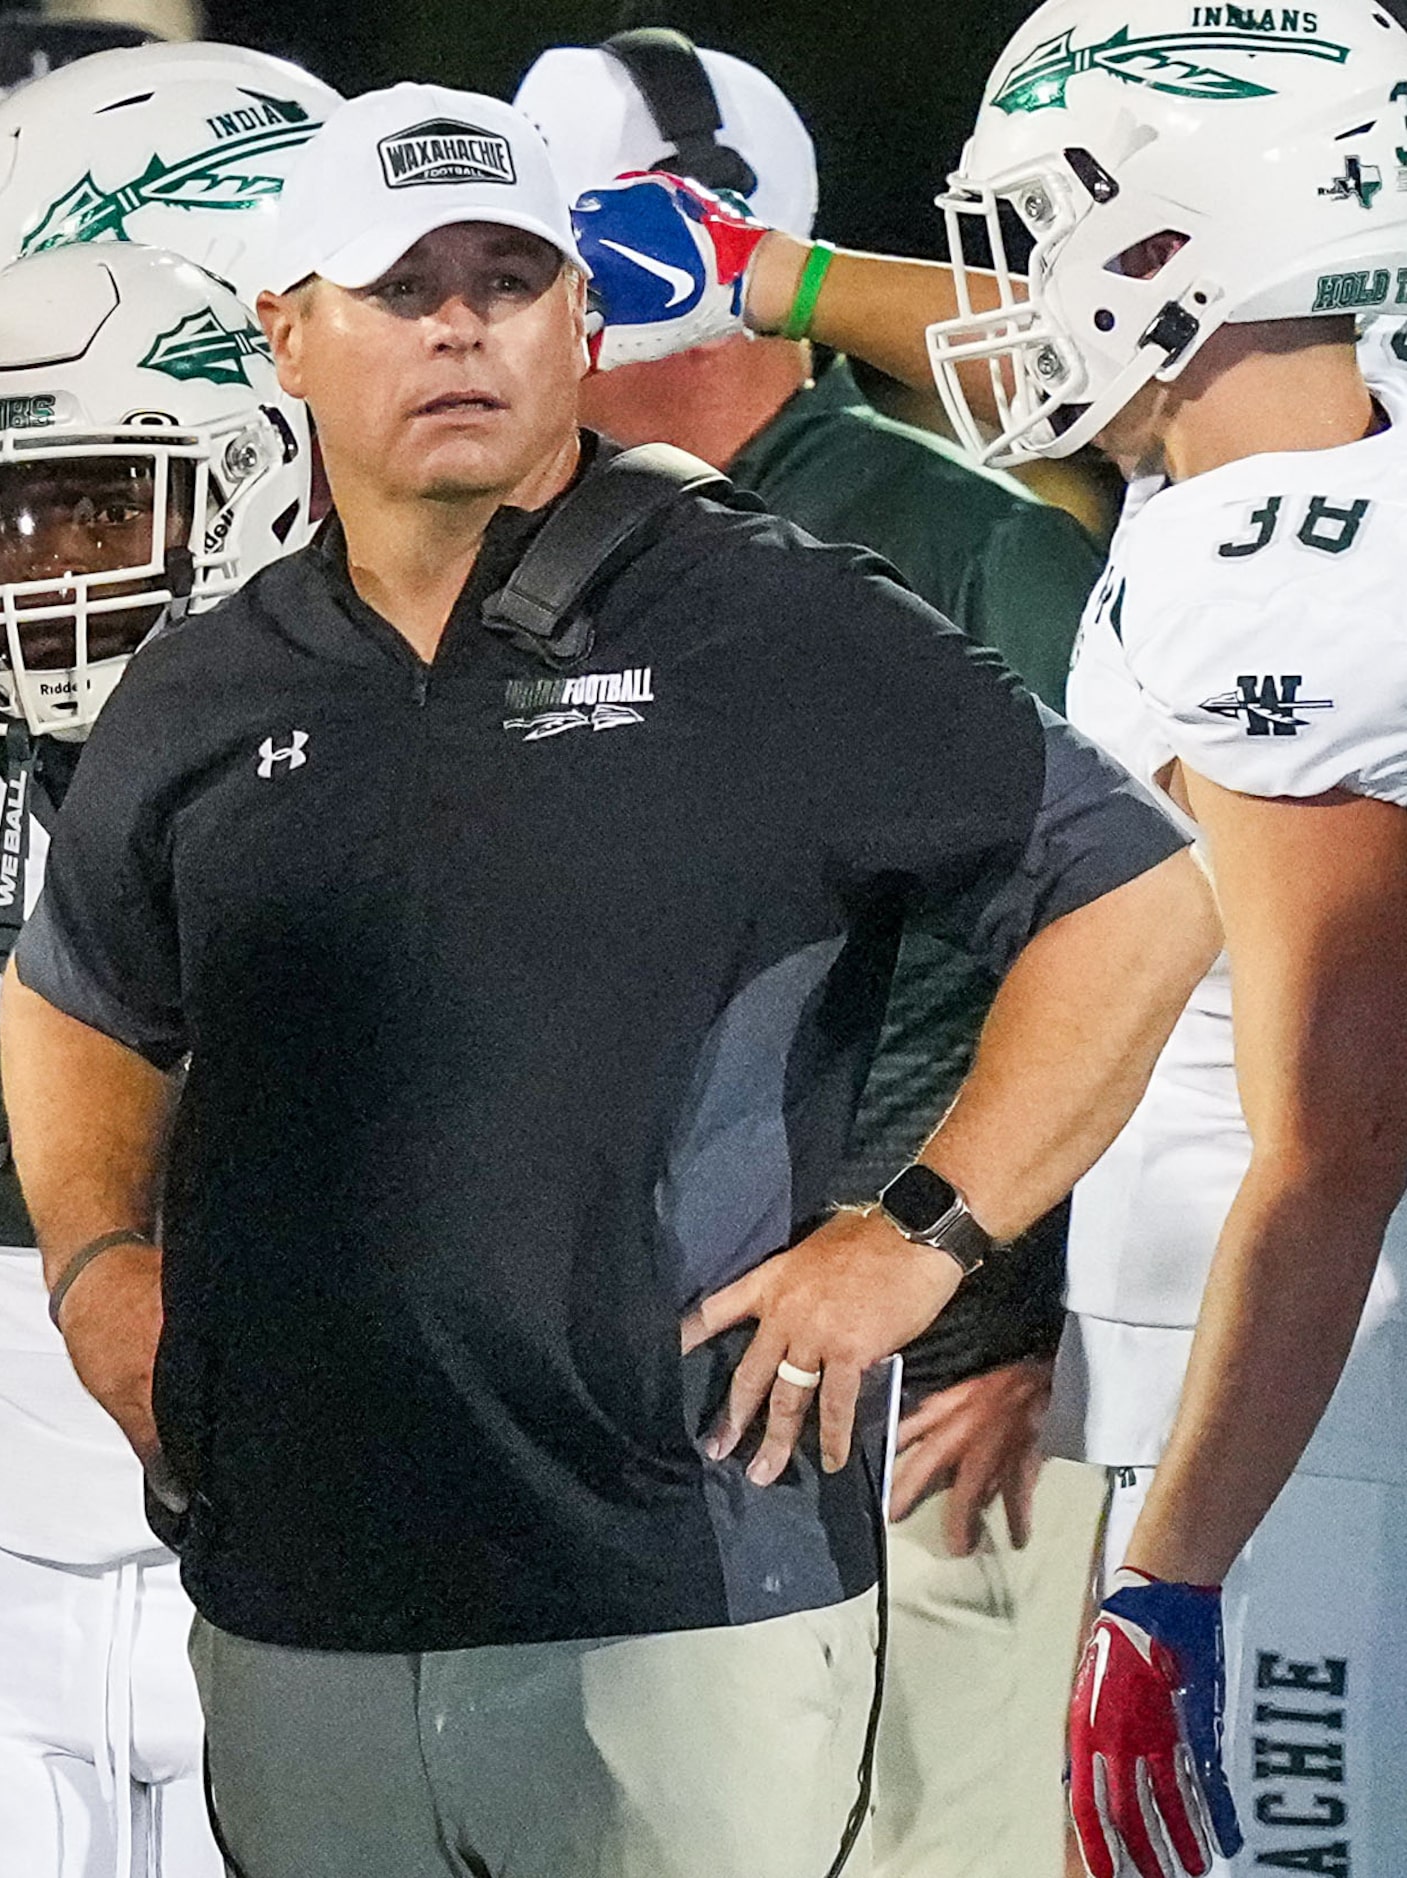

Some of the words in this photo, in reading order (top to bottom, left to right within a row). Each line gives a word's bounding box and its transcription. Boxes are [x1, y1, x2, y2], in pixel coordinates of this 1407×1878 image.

[386, 138, 510, 178] WAXAHACHIE
[423, 165, 485, 179] FOOTBALL
[1311, 268, 1391, 312] HOLD
[561, 668, 655, 705] FOOTBALL
[4, 770, 28, 854] BALL
